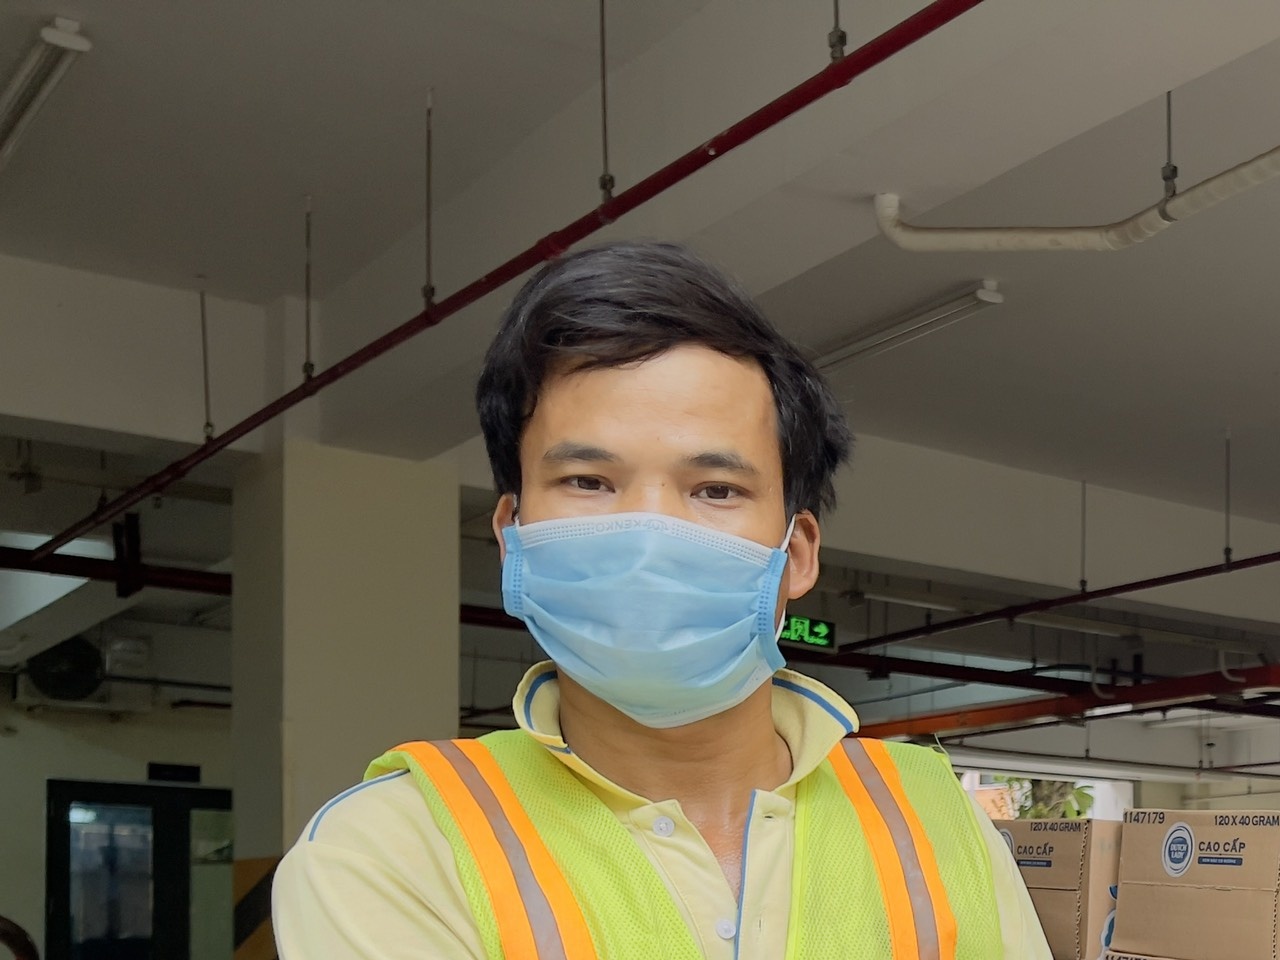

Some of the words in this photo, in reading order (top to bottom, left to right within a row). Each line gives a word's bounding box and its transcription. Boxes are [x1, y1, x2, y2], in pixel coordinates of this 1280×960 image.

[1123, 811, 1165, 824] 1147179
[1214, 815, 1230, 826] 120
[1231, 816, 1238, 826] X
[1239, 816, 1251, 827] 40
[1252, 816, 1280, 827] GRAM
[1030, 822, 1043, 832] 120
[1059, 822, 1081, 833] GRAM
[1017, 845, 1034, 855] CAO
[1036, 842, 1054, 856] CẤP
[1169, 842, 1189, 852] DUTCH
[1198, 841, 1220, 852] CAO
[1223, 838, 1246, 853] CẤP
[1171, 850, 1187, 859] LADY
